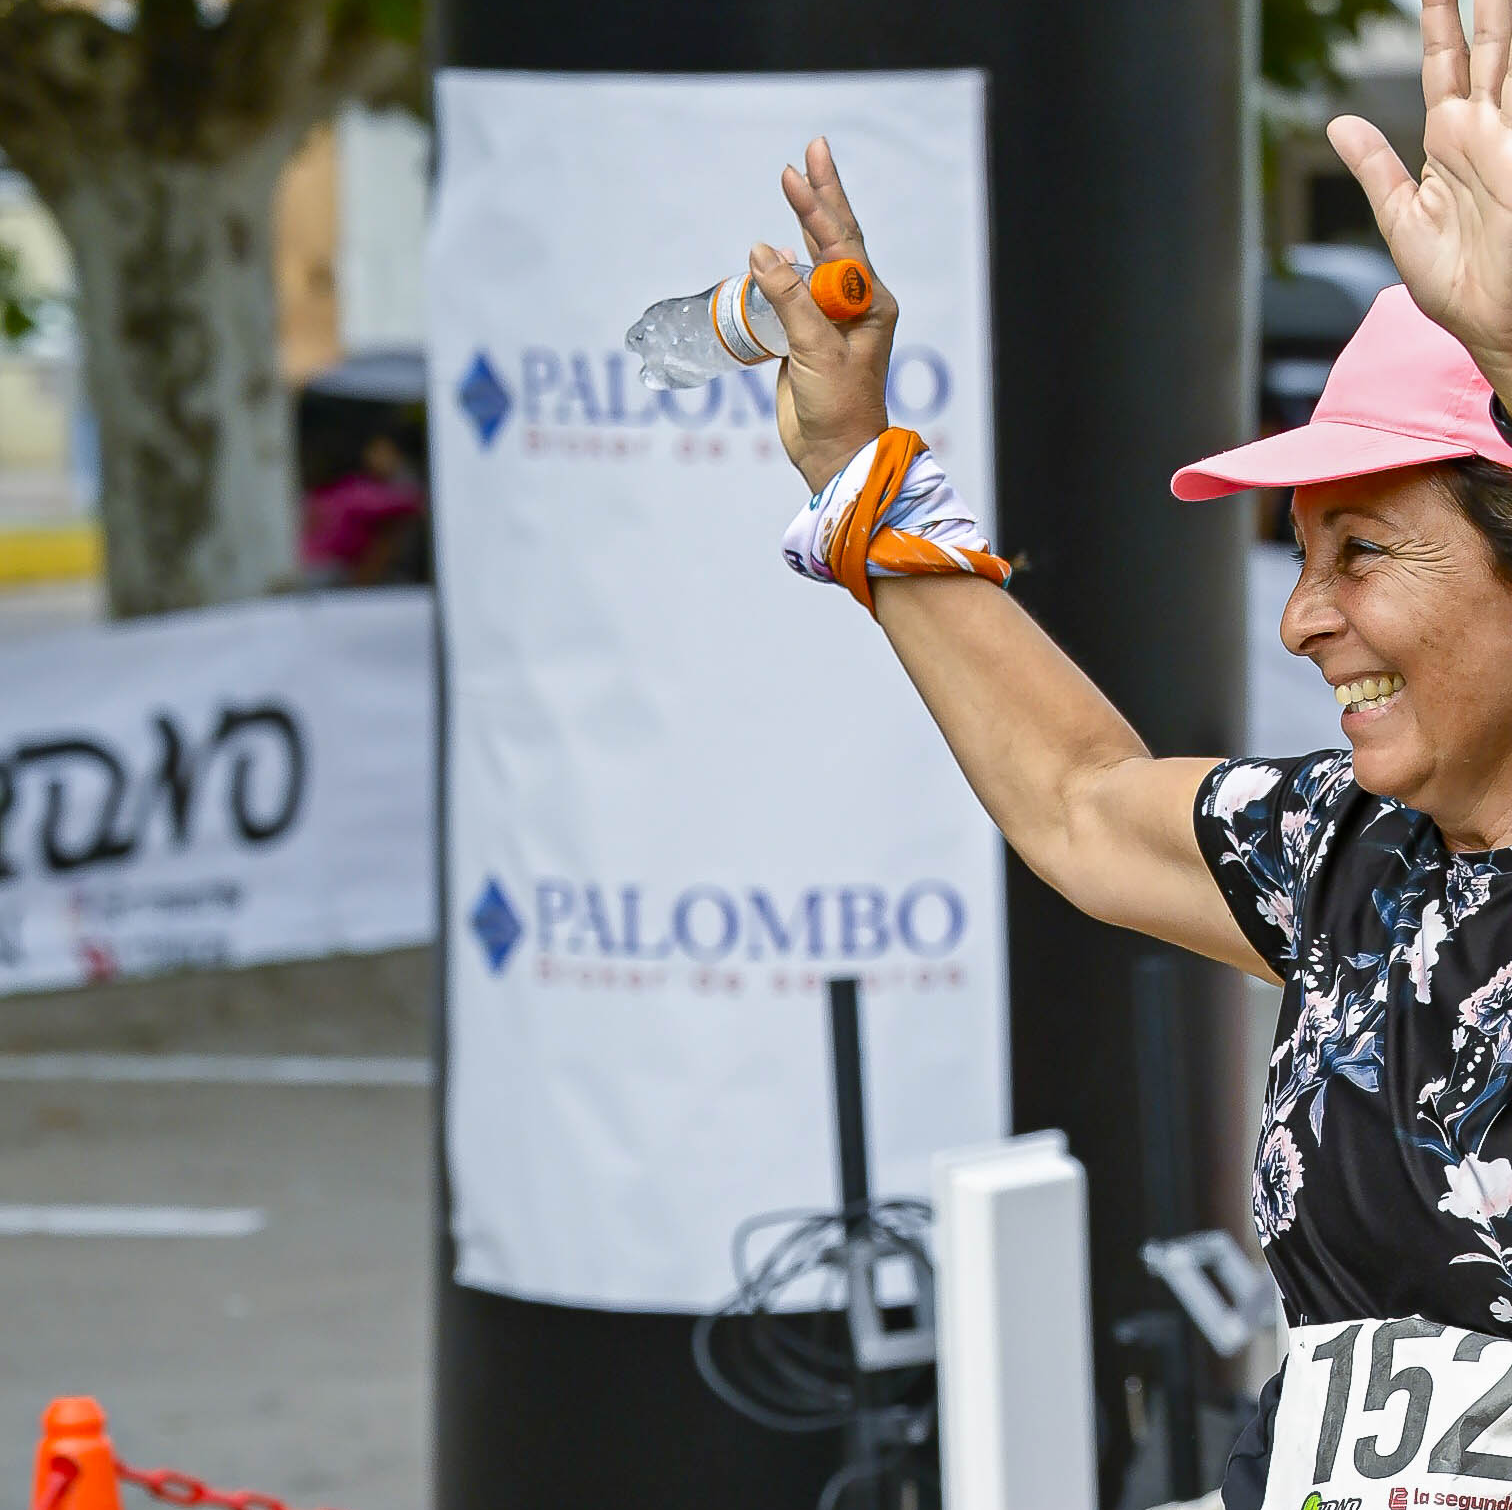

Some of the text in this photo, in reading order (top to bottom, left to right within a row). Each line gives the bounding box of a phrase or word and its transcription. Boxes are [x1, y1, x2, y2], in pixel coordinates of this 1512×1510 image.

[520, 344, 952, 431] PALOO
[533, 877, 968, 963] PALOMBO
[1413, 1487, 1430, 1505] la
